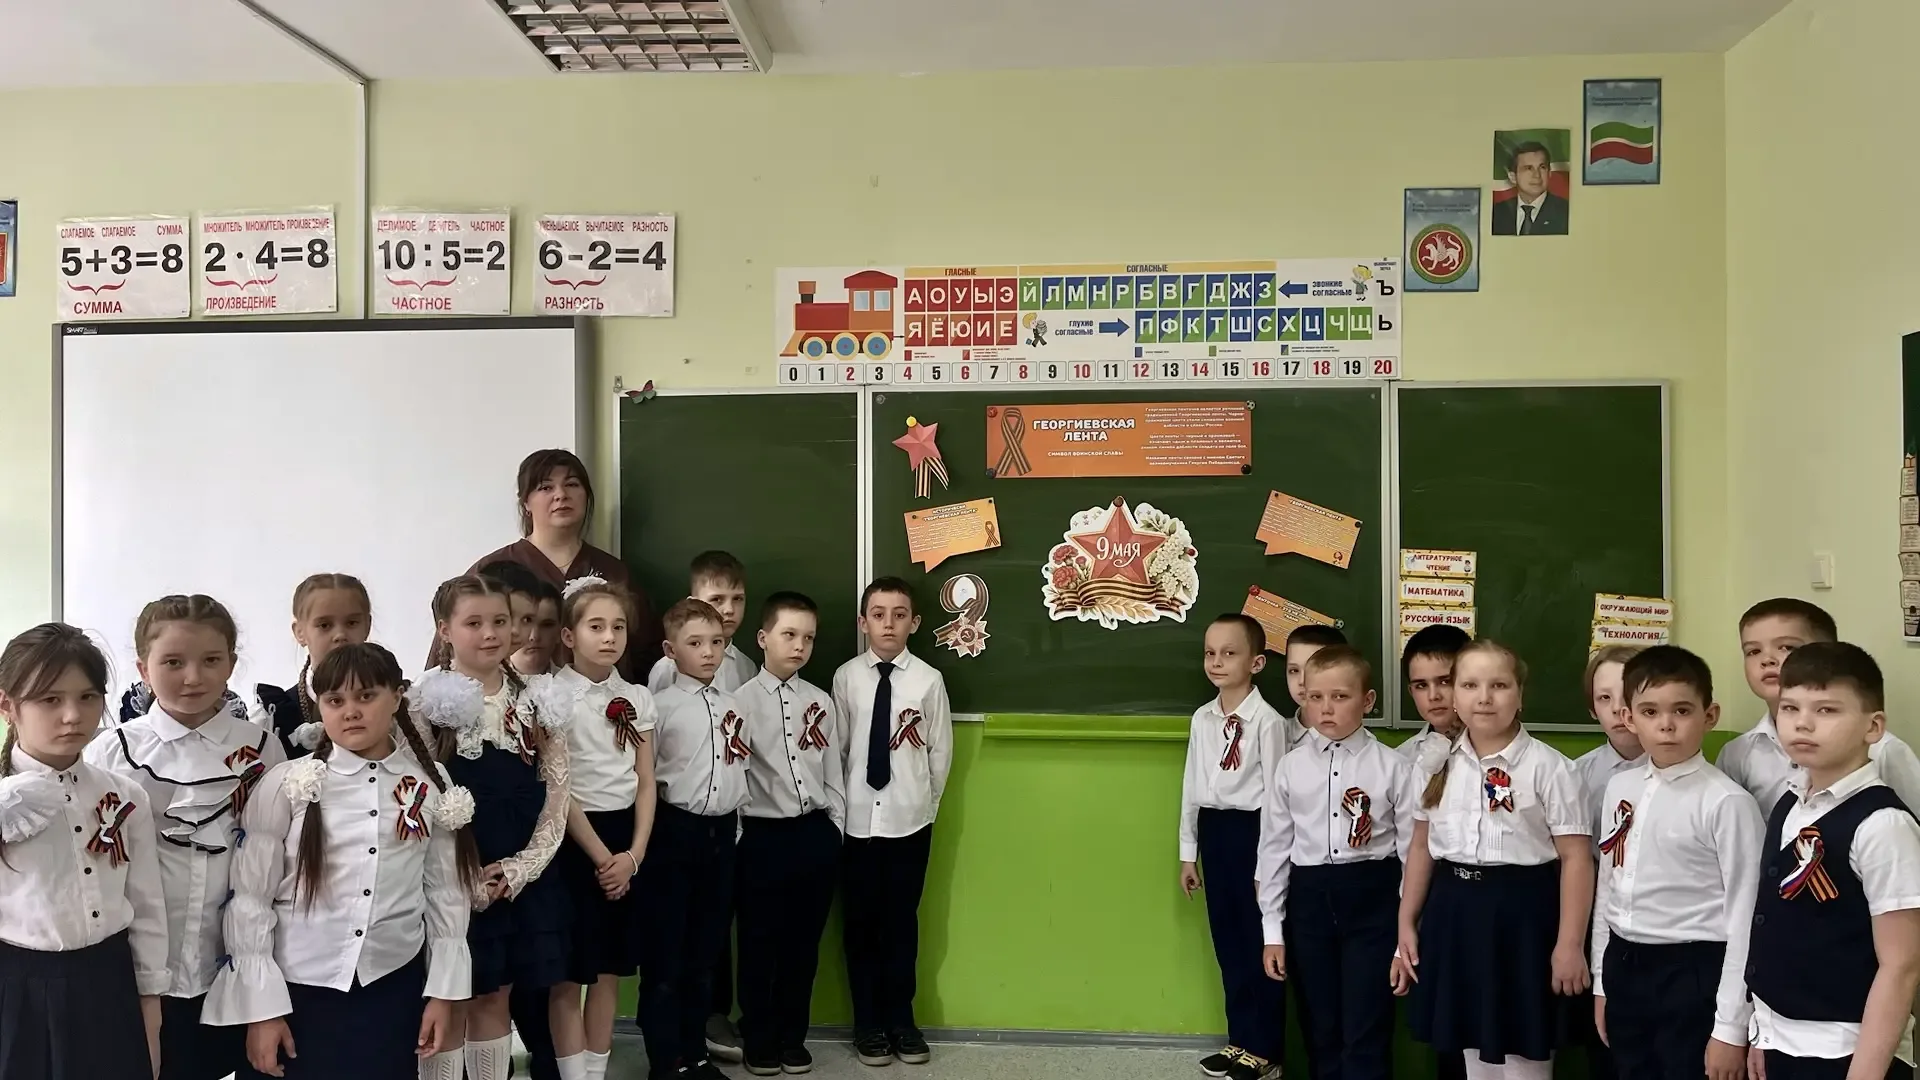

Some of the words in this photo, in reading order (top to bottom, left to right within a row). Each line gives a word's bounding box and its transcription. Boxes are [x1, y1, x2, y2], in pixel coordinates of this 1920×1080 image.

[61, 227, 95, 239] СЛАГАЕМОЕ
[101, 226, 136, 237] СЛАГАЕМОЕ
[157, 224, 183, 236] СУММА
[204, 221, 242, 233] МНОЖИТЕЛЬ
[245, 220, 285, 232] МНОЖИТЕЛЬ
[377, 220, 416, 232] ДЕЛИМОЕ
[428, 220, 460, 232] ДЕИТЕЛЬ
[470, 220, 505, 231] ЧАСТНОЕ
[586, 221, 624, 232] ВЫЧИТАЕМОЕ
[632, 221, 669, 232] РАЗНОСТЬ
[944, 268, 977, 277] ГЛАСНЫЕ
[1126, 264, 1169, 273] СОГЛАСНЫЕ
[1376, 280, 1395, 296] Ъ
[74, 300, 122, 314] СУММА
[206, 296, 276, 311] ПРОИЗВЕДЕНИЕ
[391, 296, 452, 311] ЧАСТНОЕ
[544, 296, 604, 310] РАЗНОСТЬ
[1378, 314, 1393, 331] Ь
[789, 367, 798, 382] 0
[818, 367, 825, 381] 1
[846, 367, 855, 381] 2
[875, 366, 884, 381] 3
[903, 366, 912, 380] 4
[932, 366, 941, 380] 5
[961, 365, 970, 380] 6
[989, 365, 999, 380] 7
[1018, 364, 1028, 379] 8
[1048, 364, 1057, 379] 9
[1073, 364, 1091, 379] 10
[1103, 363, 1118, 378] 11
[1132, 363, 1150, 378] 12
[1162, 363, 1179, 377] 13
[1191, 362, 1209, 377] 14
[1222, 362, 1239, 376] 15
[1252, 361, 1270, 376] 16
[1282, 361, 1300, 375] 17
[1313, 360, 1331, 375] 18
[1344, 360, 1361, 375] 19
[1374, 360, 1392, 374] 20
[1033, 418, 1136, 431] ГЕОРГИЕВСКАЯ
[1063, 431, 1108, 442] ЛЕНТА
[1096, 536, 1110, 560] 9
[1413, 554, 1462, 562] ЛИТЕРАТУРНОЕ
[1408, 587, 1464, 597] МАТЕМАТИКА
[1600, 603, 1653, 614] ОКРУЖАЮЩИЙ
[1405, 613, 1444, 624] РУССКИЙ
[1446, 616, 1471, 624] ЯЗЫК
[1603, 630, 1659, 640] ТЕХНОЛОГИЯ
